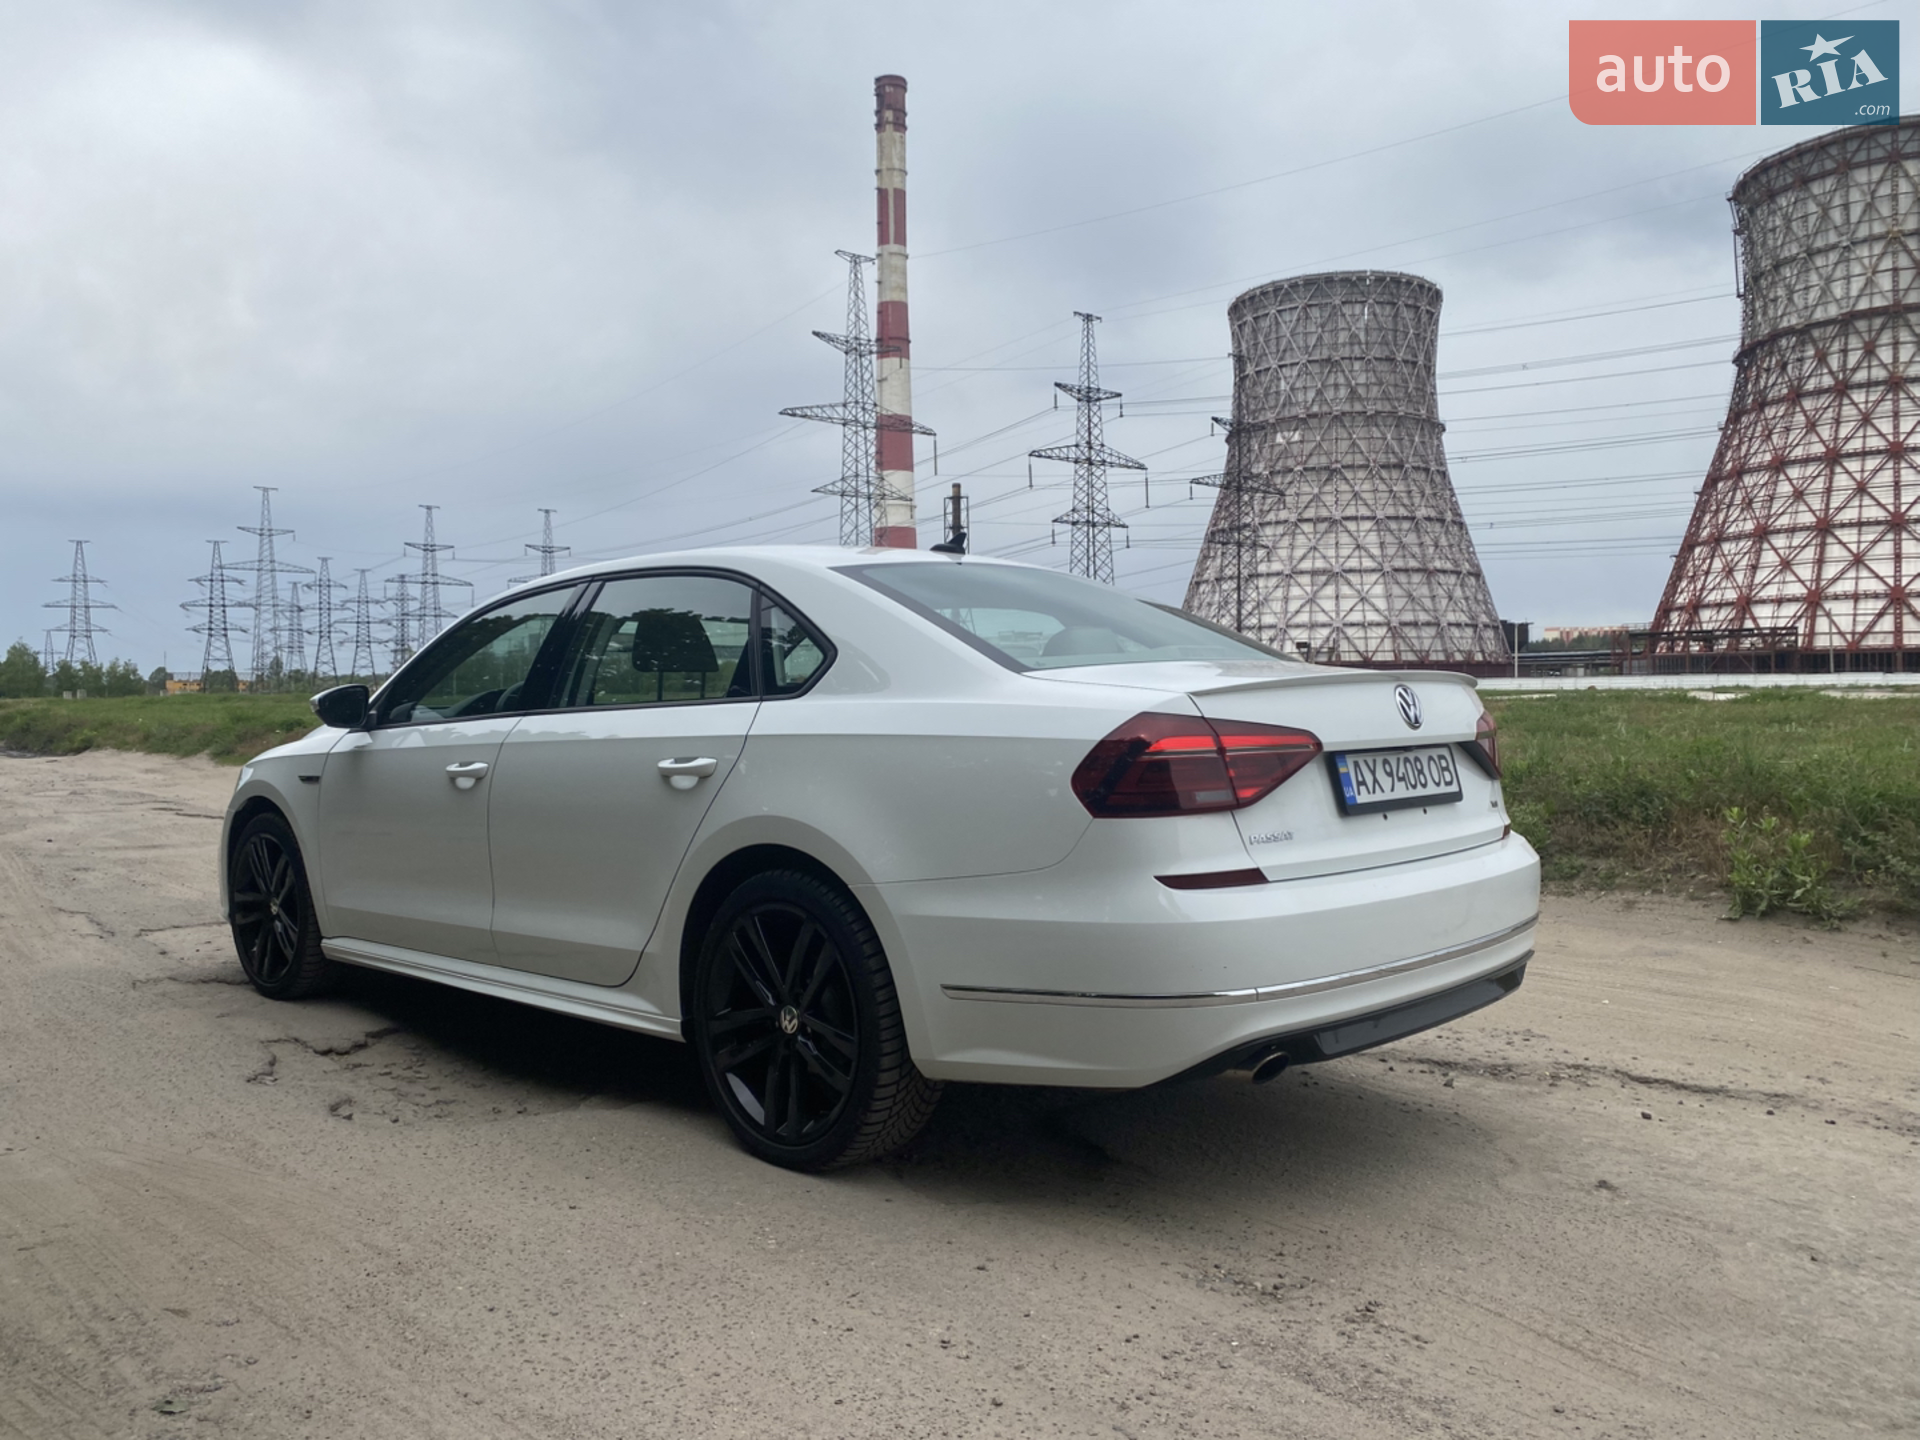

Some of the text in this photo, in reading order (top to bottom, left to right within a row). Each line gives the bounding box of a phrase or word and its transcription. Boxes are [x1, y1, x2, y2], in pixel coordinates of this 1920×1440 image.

[1353, 754, 1454, 796] AX 9408 OB
[1344, 786, 1355, 798] UA
[1249, 830, 1293, 846] PASSAT
